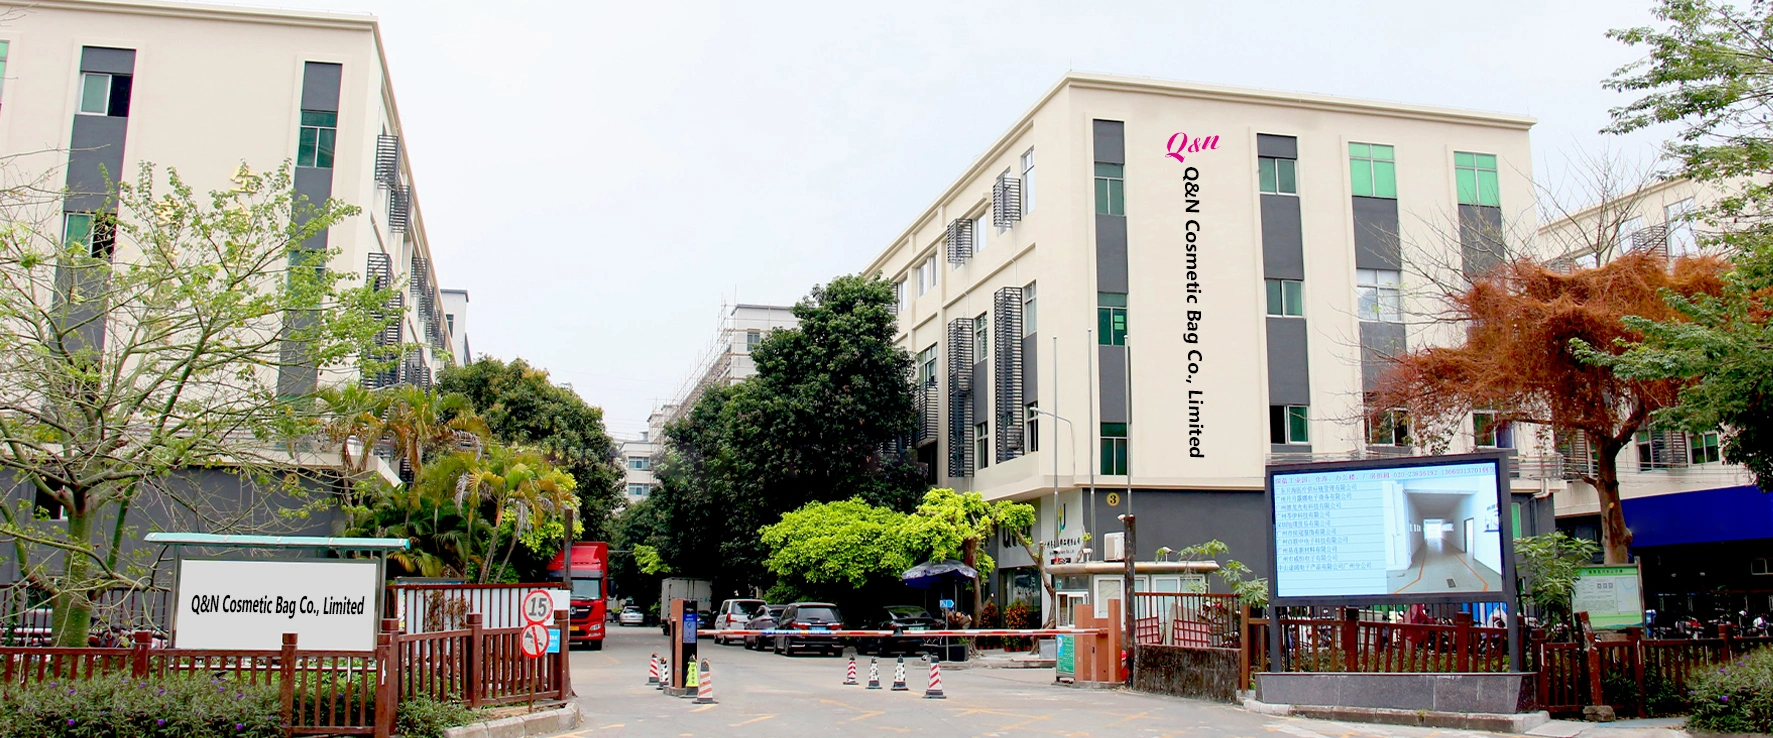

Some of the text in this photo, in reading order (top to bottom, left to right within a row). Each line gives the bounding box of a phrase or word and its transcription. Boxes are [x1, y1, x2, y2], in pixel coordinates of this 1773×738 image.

[1183, 167, 1205, 457] Q&N Cosmetic Bag Co., Limited
[1110, 494, 1117, 504] 3
[191, 594, 365, 619] Q&N Cosmetic Bag Co., Limited
[528, 597, 548, 617] 15
